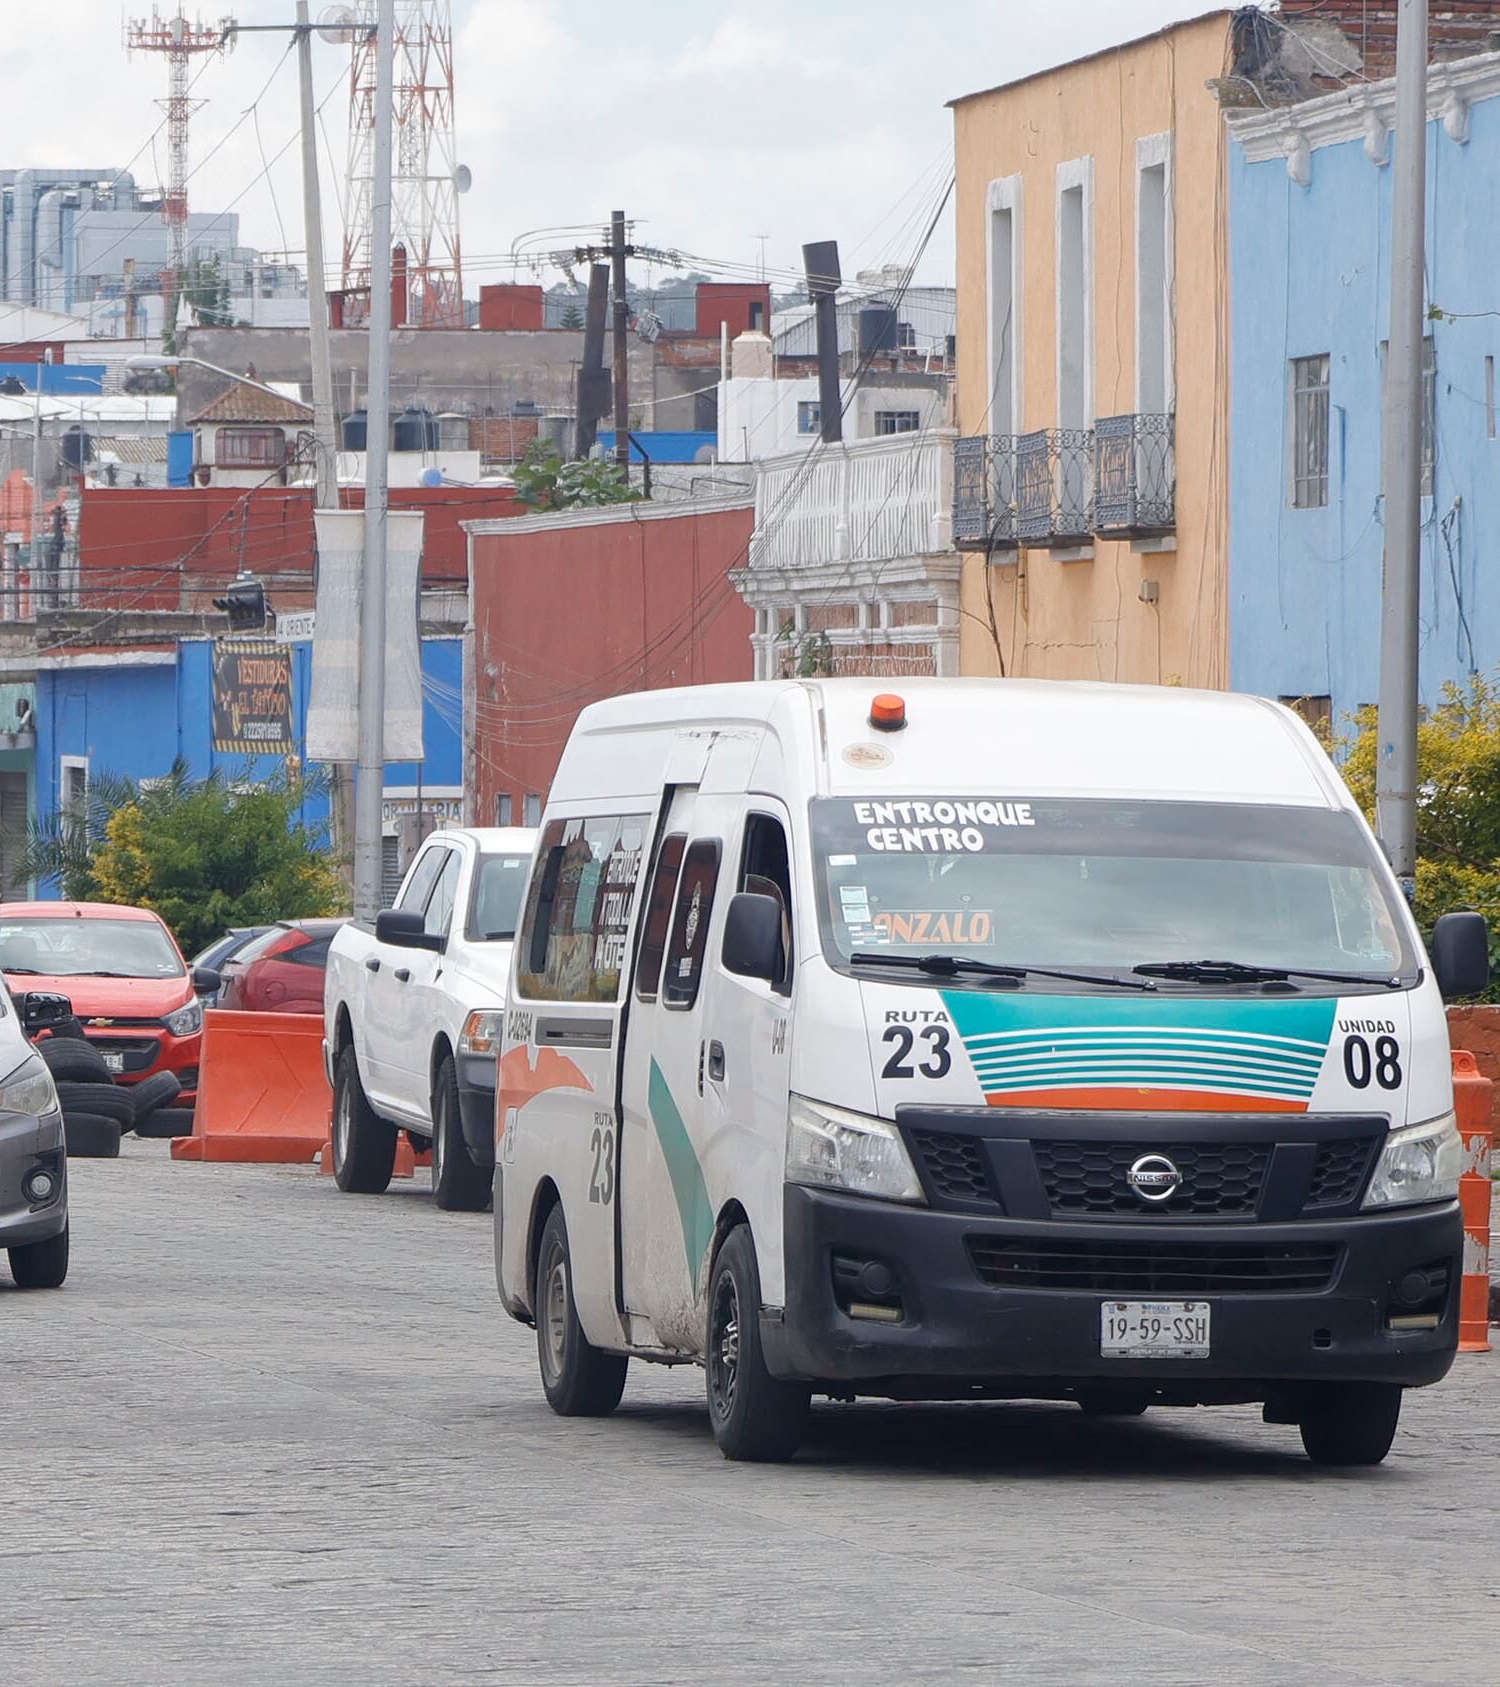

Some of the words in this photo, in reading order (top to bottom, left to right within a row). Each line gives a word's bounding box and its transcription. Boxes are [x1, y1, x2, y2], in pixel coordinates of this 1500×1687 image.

[853, 801, 1035, 827] ENTRONQUE
[866, 827, 985, 853] CENTRO
[885, 1010, 948, 1023] RUTA
[1339, 1020, 1396, 1034] UNIDAD
[881, 1025, 951, 1079] 23
[1343, 1035, 1402, 1091] 08
[594, 1111, 613, 1126] RUTA
[589, 1127, 614, 1206] 23
[1134, 1174, 1178, 1183] NISSAN
[1108, 1317, 1206, 1341] 19-59-SSH
